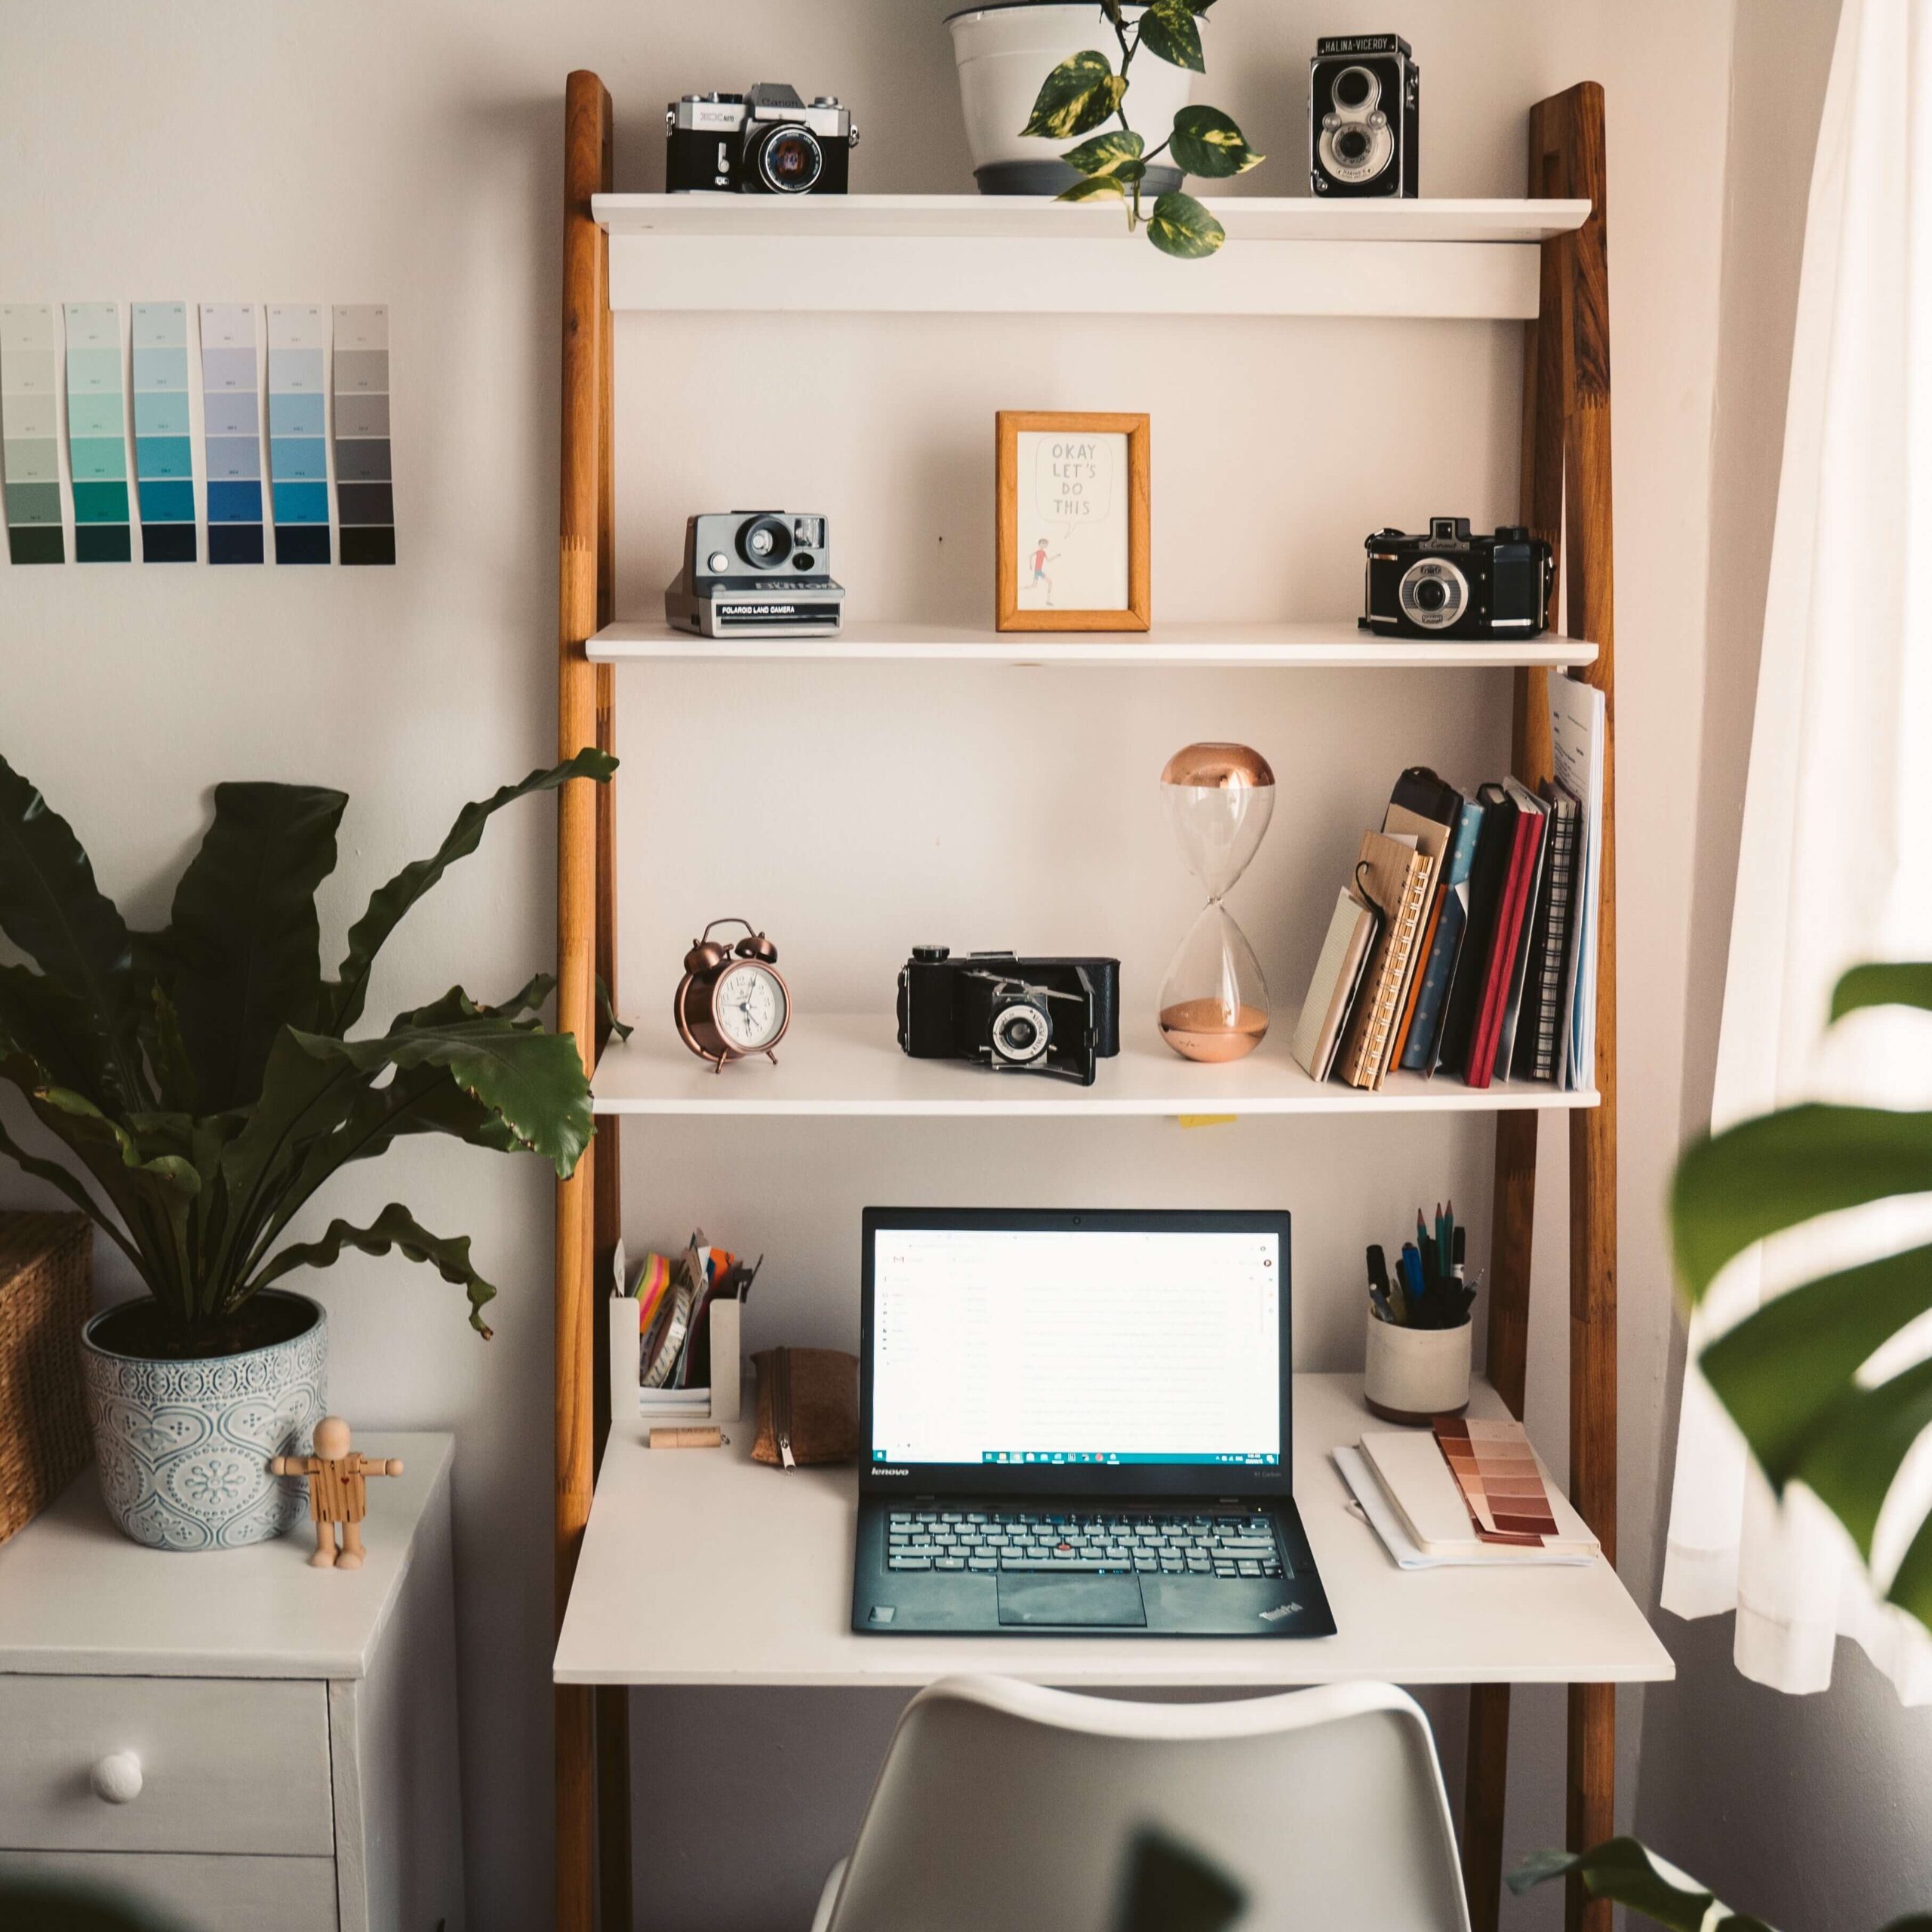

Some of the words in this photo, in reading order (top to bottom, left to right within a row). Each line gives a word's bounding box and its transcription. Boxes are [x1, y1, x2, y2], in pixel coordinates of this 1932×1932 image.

[1325, 38, 1388, 52] HALINA-VICEROY
[761, 98, 798, 107] Canon
[1052, 443, 1096, 460] OKAY
[1053, 463, 1096, 478] LET'S
[1062, 482, 1083, 495] DO
[1053, 499, 1090, 515] THIS
[755, 582, 837, 590] Button
[722, 606, 752, 614] POLAROID
[872, 1467, 909, 1476] lenovo
